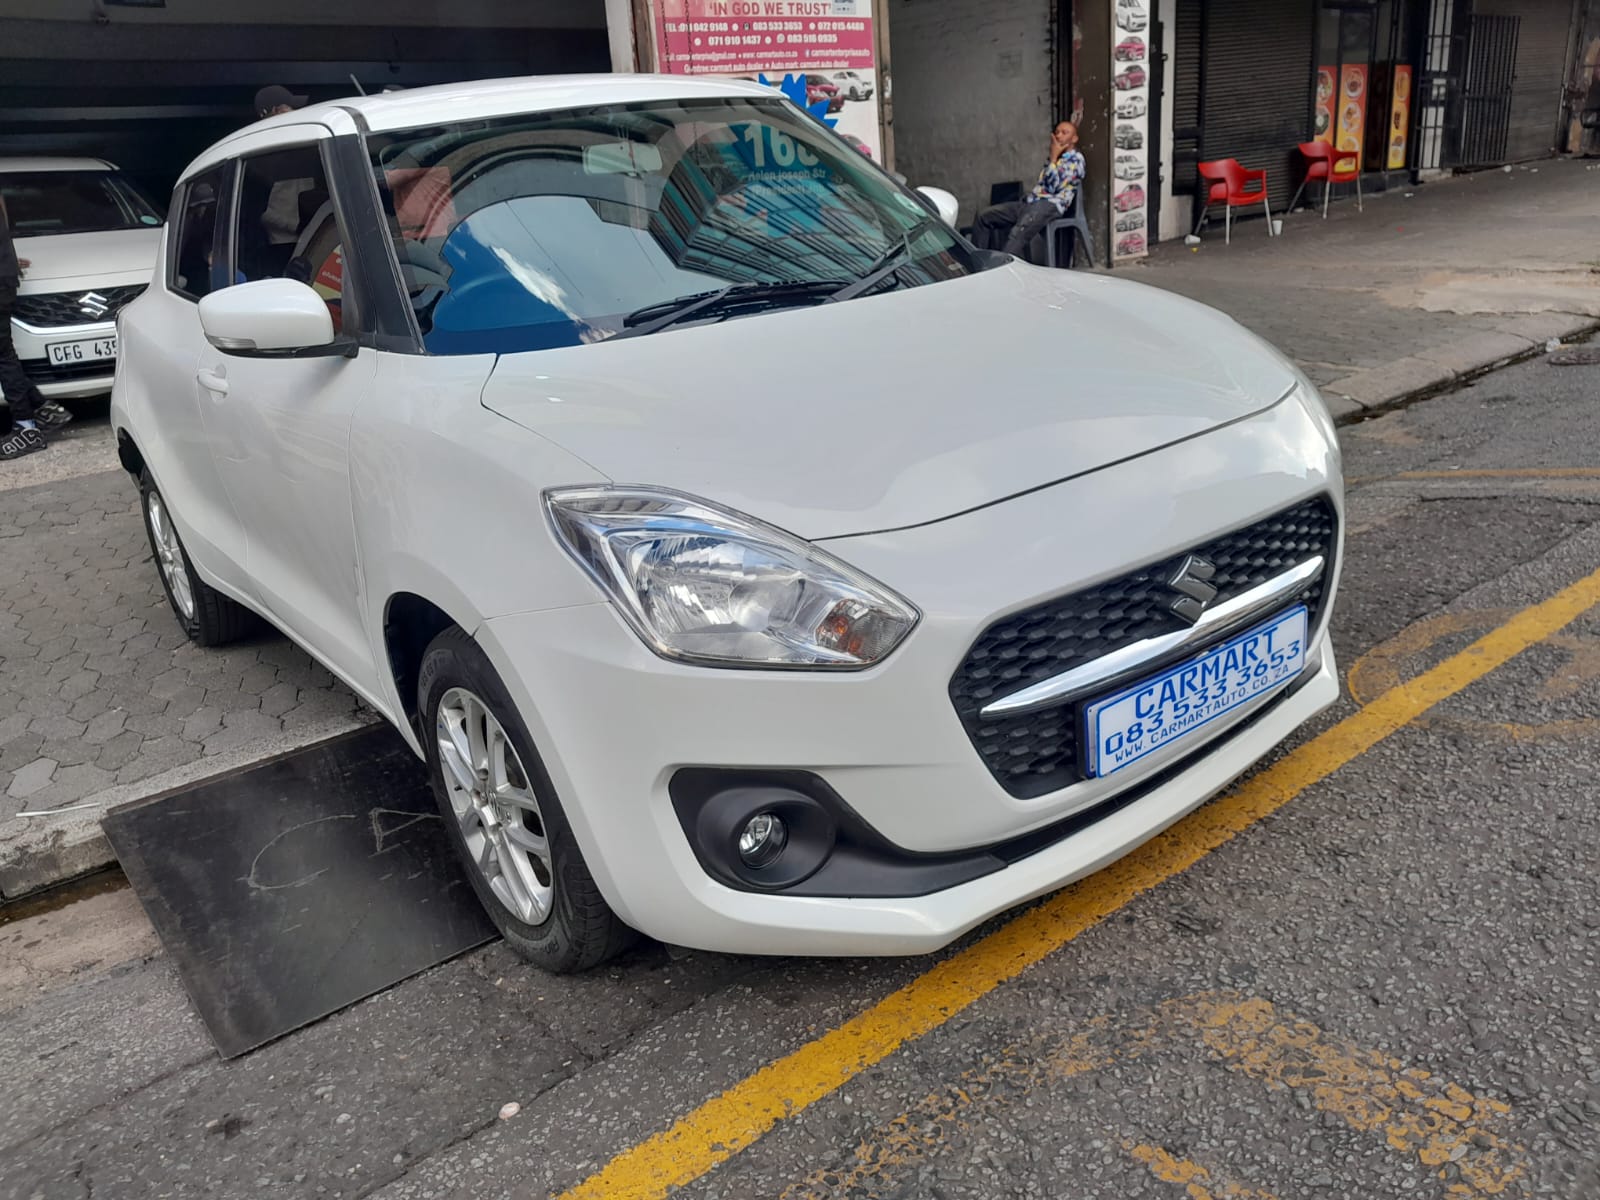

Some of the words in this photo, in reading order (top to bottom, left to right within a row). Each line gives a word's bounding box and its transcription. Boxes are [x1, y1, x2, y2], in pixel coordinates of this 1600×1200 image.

[732, 2, 760, 15] GOD
[764, 2, 783, 15] WE
[708, 36, 723, 46] 071
[53, 344, 83, 362] CFG
[1134, 626, 1279, 720] CARMART
[1105, 711, 1164, 756] 083
[1173, 679, 1227, 720] 533
[1236, 640, 1301, 687] 3653
